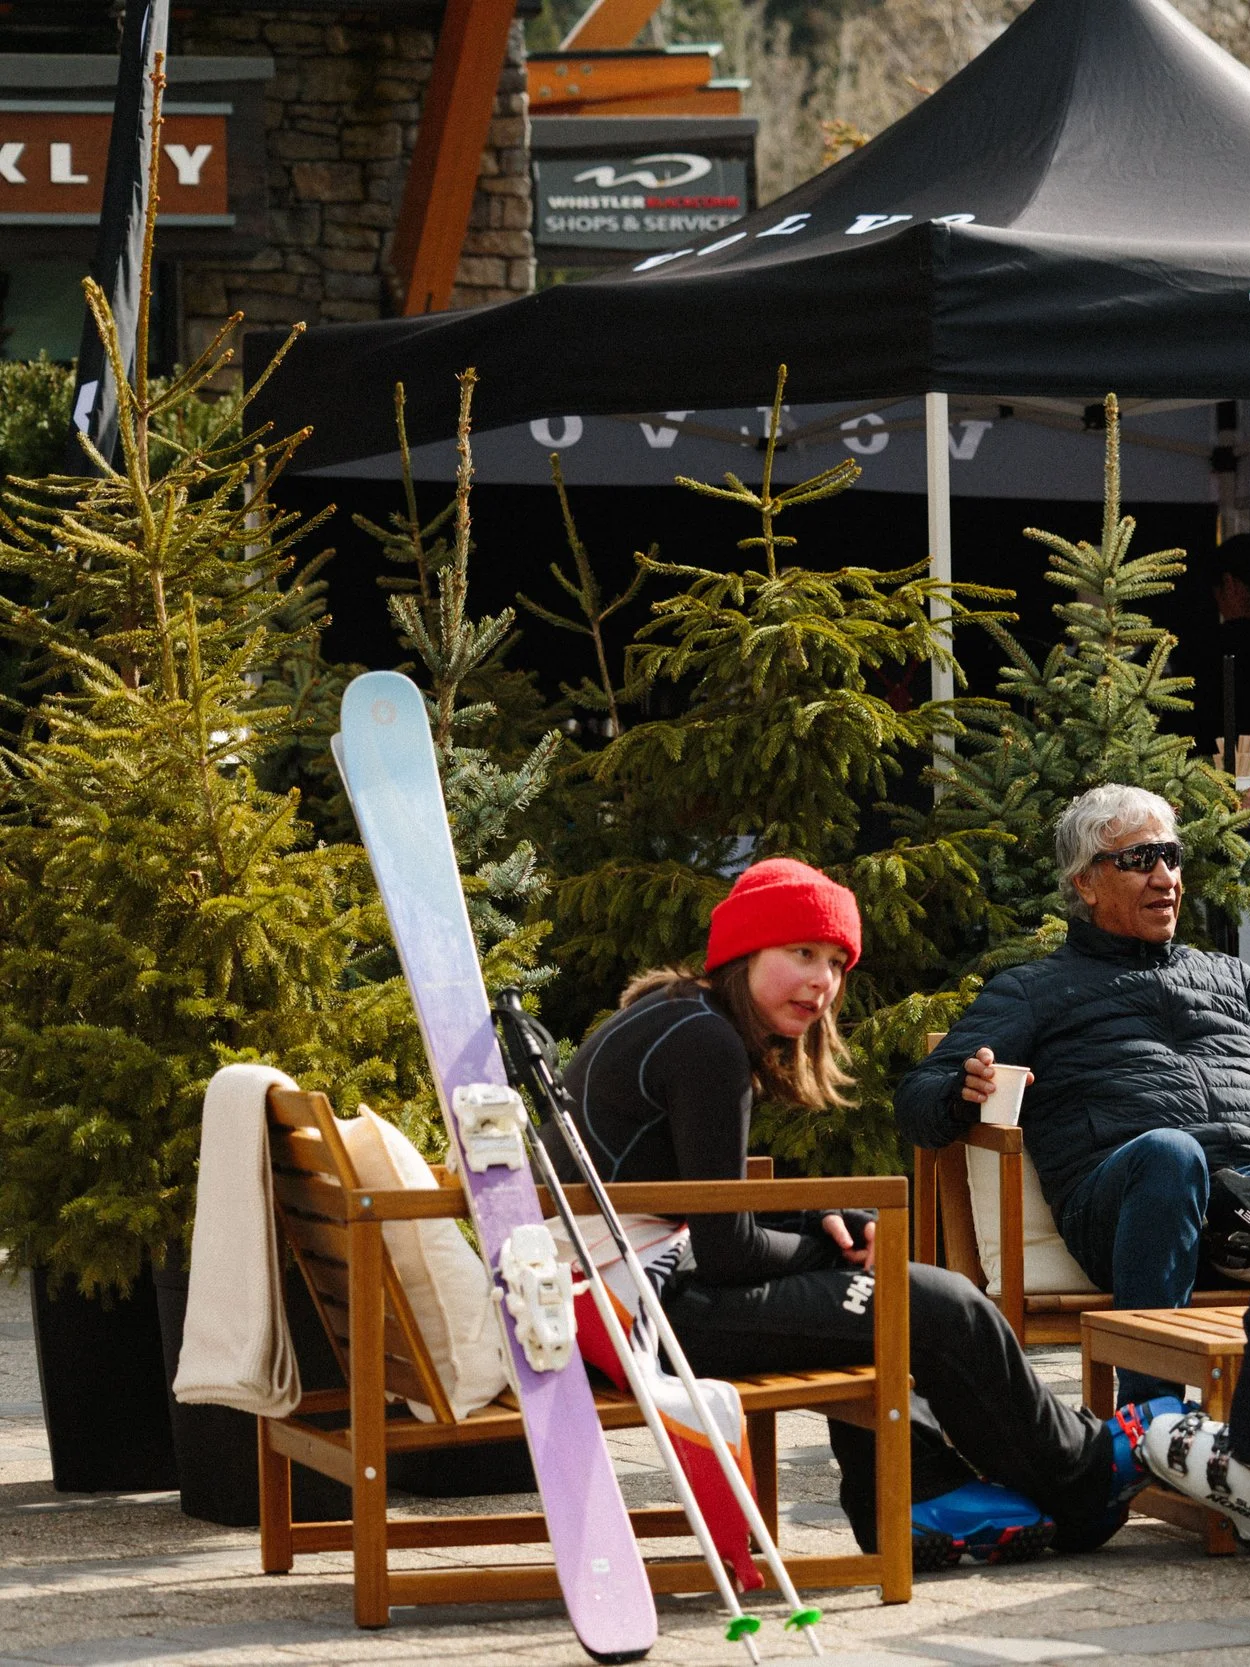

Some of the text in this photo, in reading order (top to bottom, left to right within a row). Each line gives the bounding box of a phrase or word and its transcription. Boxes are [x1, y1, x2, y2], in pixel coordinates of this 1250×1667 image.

[0, 143, 213, 185] KLY
[545, 214, 620, 233] SHOPS
[622, 214, 640, 232] &
